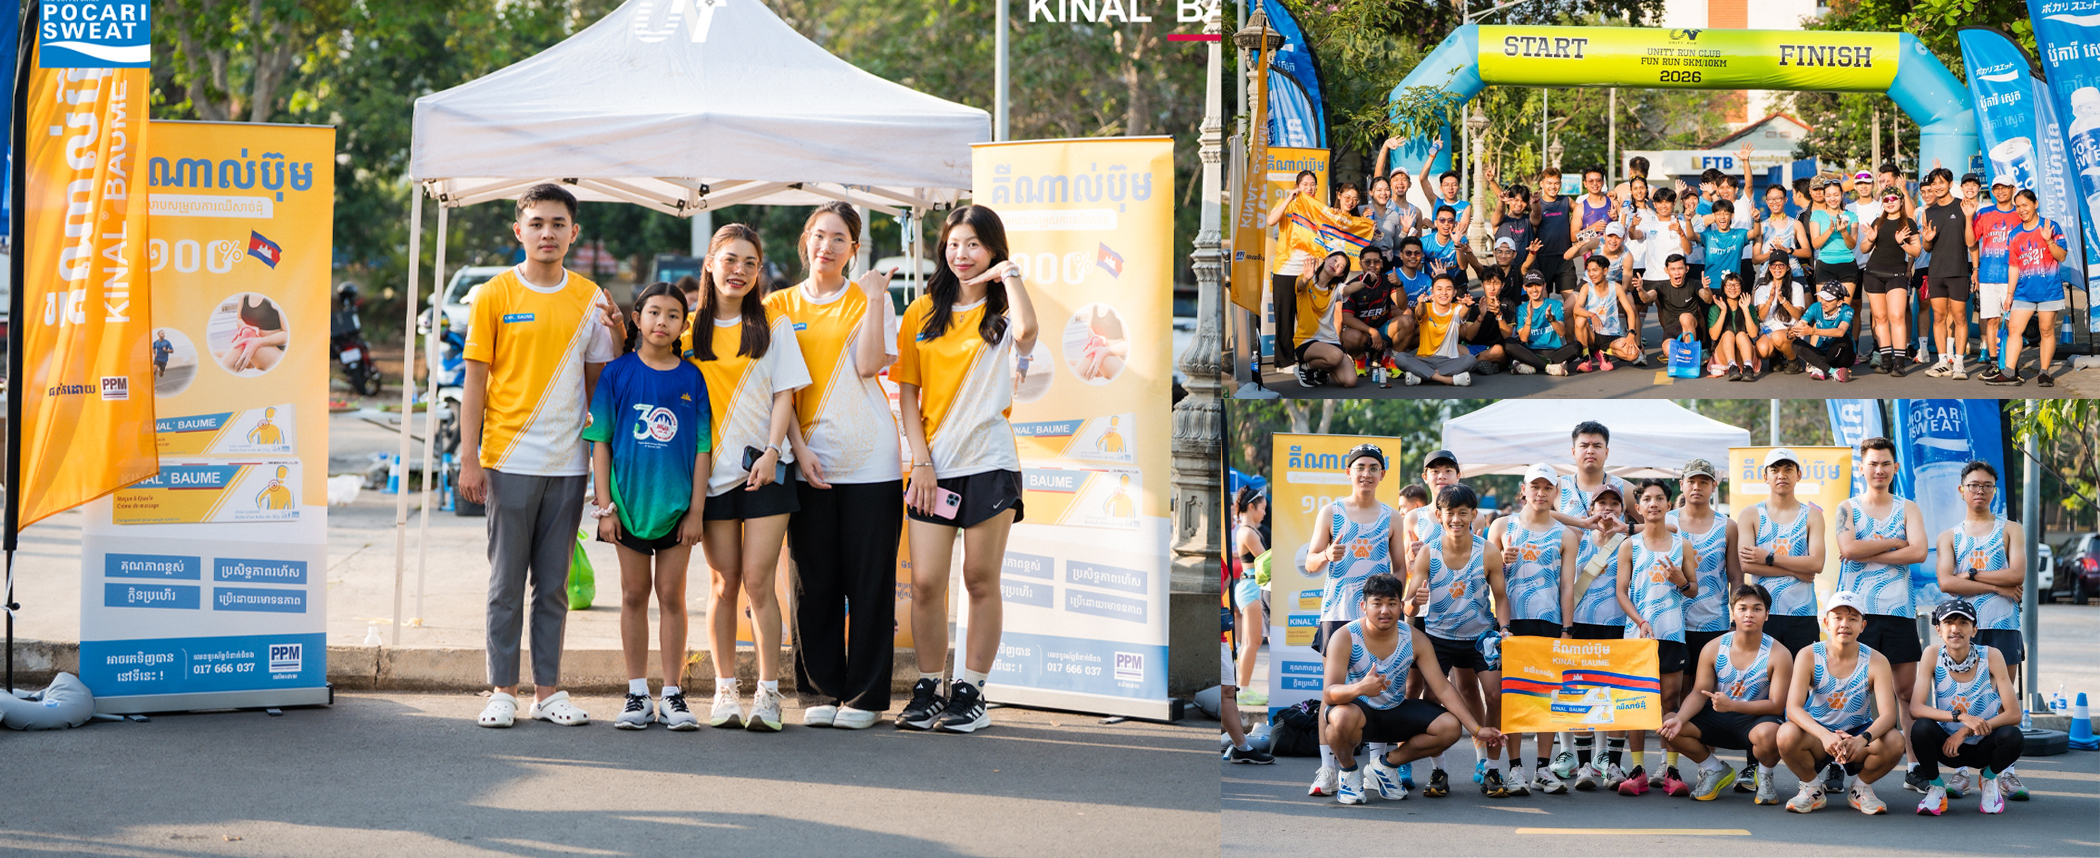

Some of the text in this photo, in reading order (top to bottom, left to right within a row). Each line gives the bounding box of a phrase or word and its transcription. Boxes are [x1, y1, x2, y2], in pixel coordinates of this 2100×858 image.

[2041, 2, 2068, 14] ポカリ
[1504, 35, 1588, 59] START
[1647, 48, 1721, 58] UNITY RUN CLUB
[1641, 57, 1659, 66] FUN
[1662, 57, 1681, 66] RUN
[1779, 44, 1872, 68] FINISH
[1660, 70, 1702, 83] 2026
[1702, 156, 1733, 169] FTB
[991, 161, 1152, 213] គីណាល់ប៊ុម
[102, 79, 130, 323] KINAL BAUME
[178, 418, 217, 429] BAUME
[1036, 424, 1070, 434] BAUME
[170, 472, 221, 484] BAUME
[1029, 474, 1073, 488] BAUME
[1552, 639, 1611, 657] គីណាល់ប៊ុម
[193, 662, 255, 674] 017 666 037
[1552, 657, 1609, 667] KINAL BAUME
[1047, 662, 1102, 676] 017 666 037
